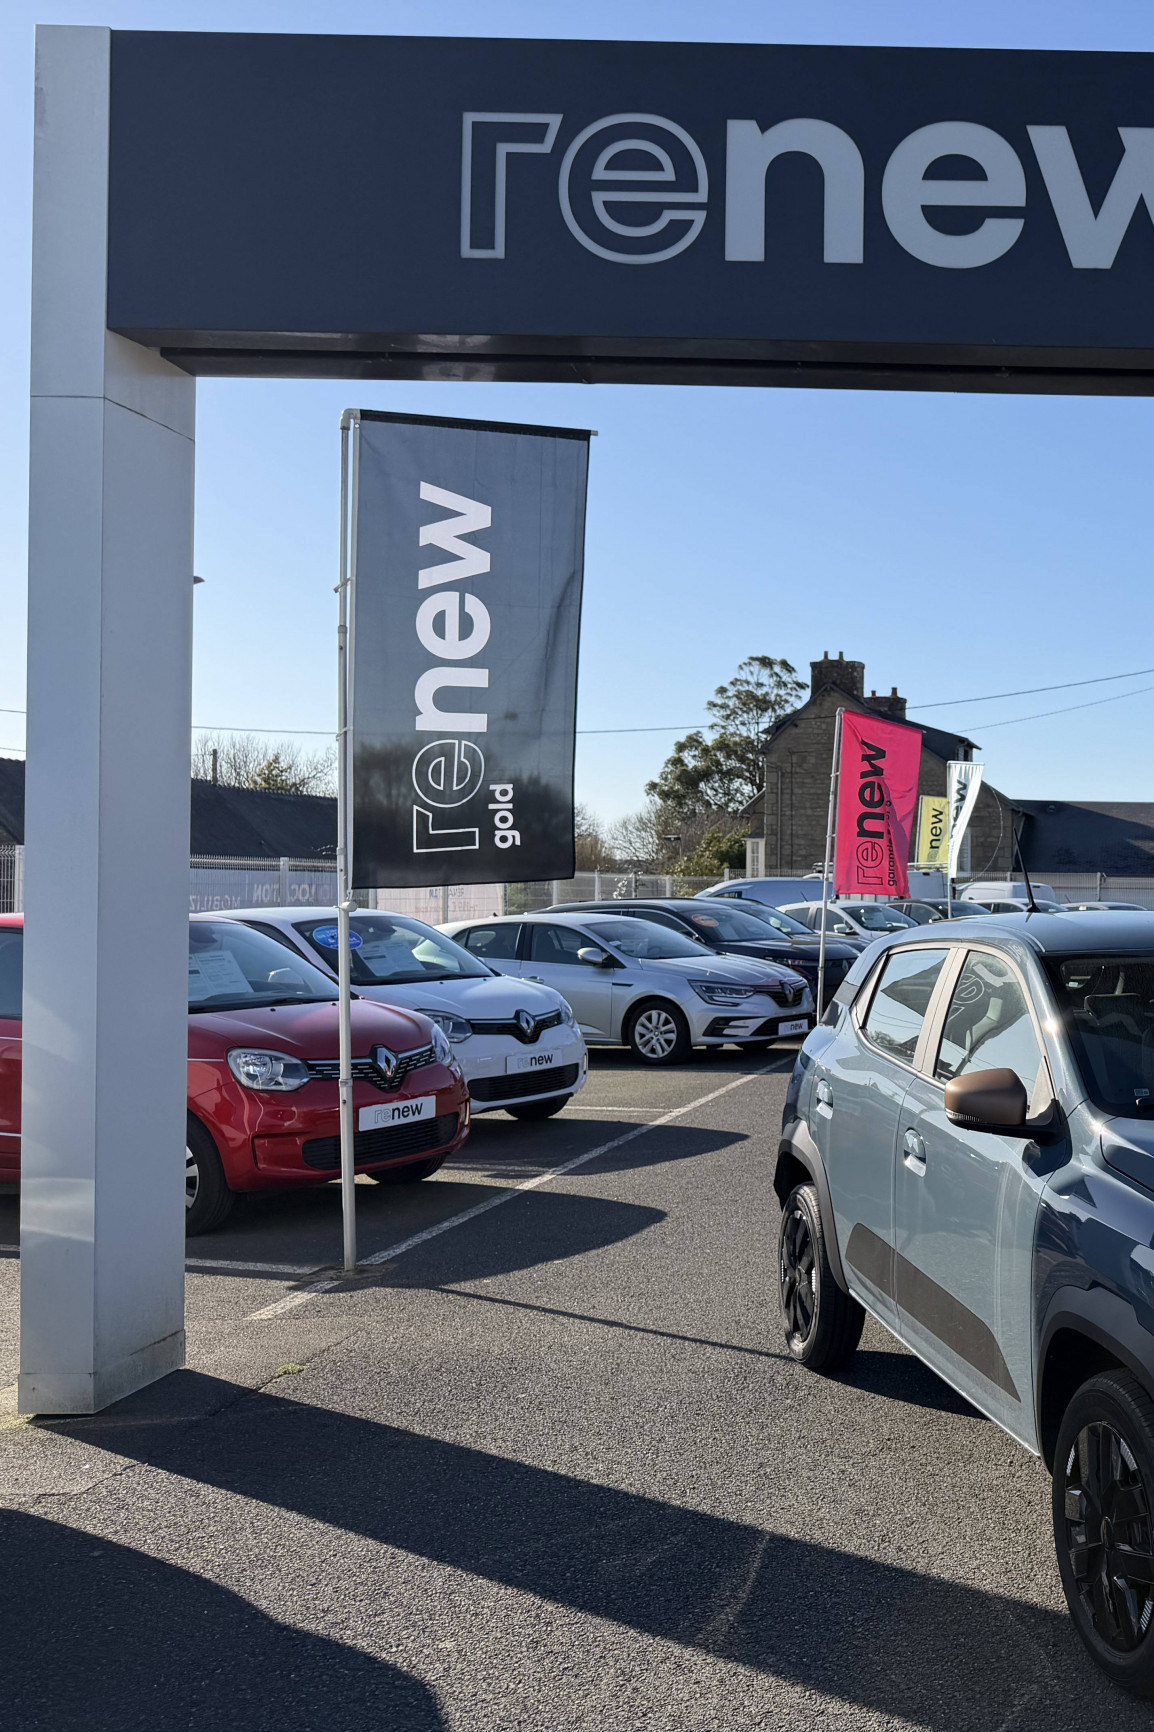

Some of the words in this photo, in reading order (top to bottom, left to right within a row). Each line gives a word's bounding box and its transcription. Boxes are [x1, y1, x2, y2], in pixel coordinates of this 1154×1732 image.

[412, 481, 492, 853] renew
[488, 783, 520, 849] gold
[856, 738, 887, 886] renew
[374, 1102, 423, 1124] renew
